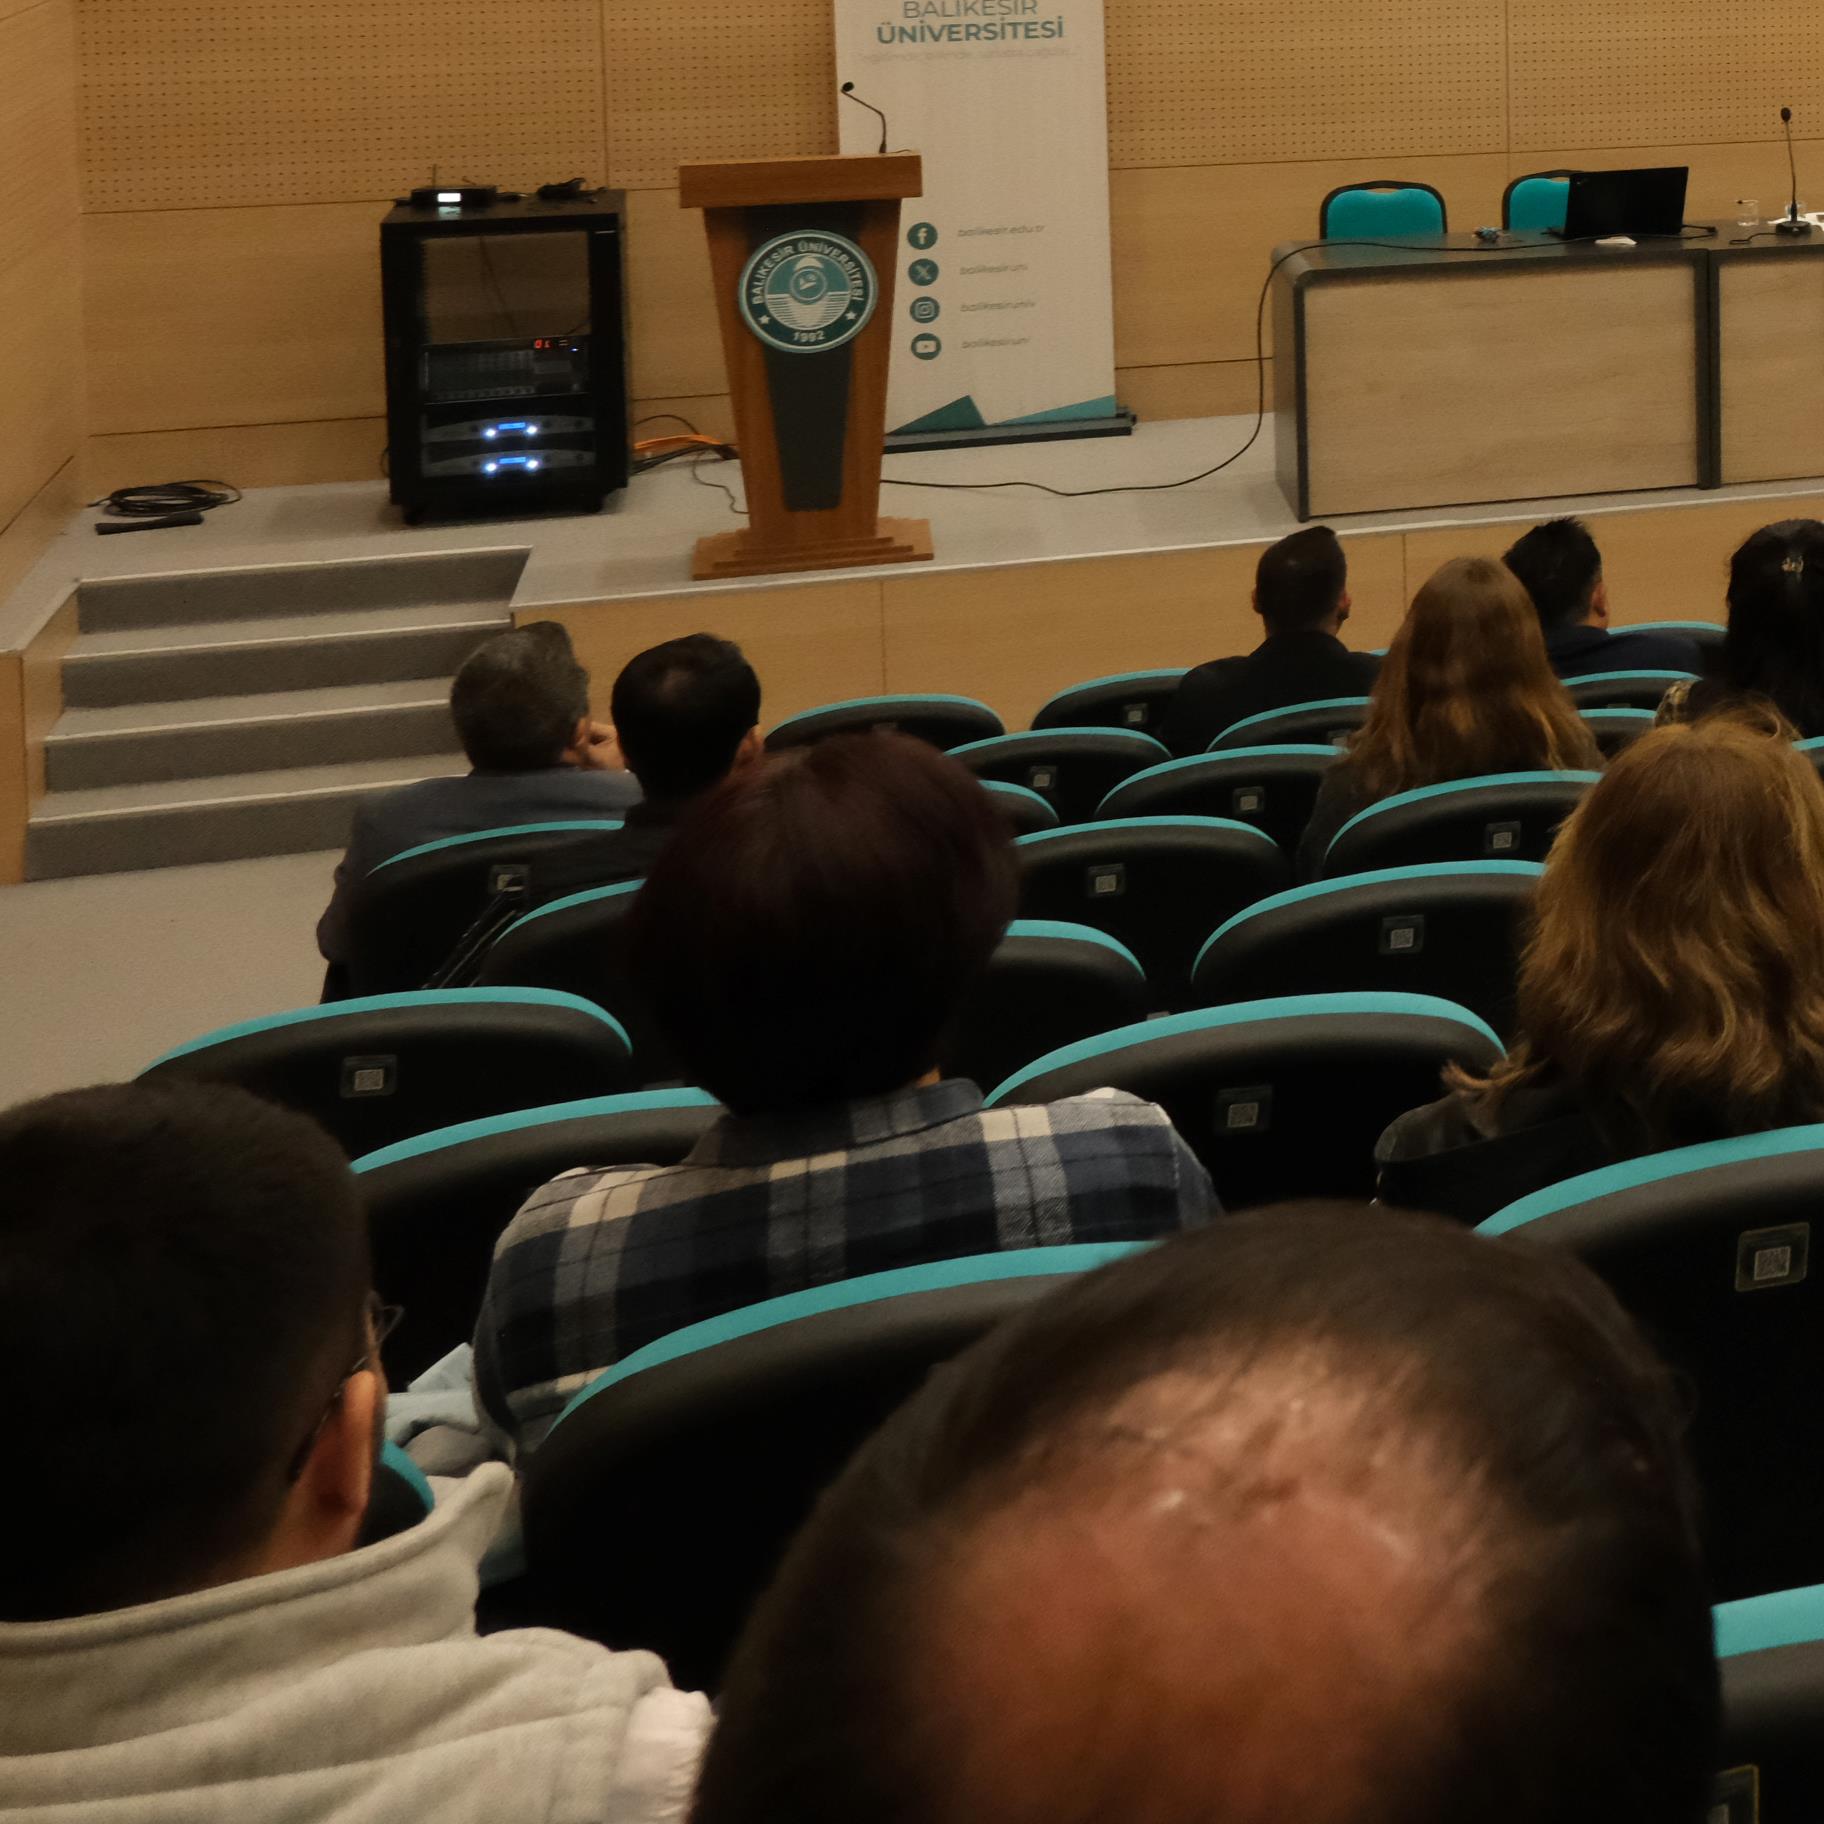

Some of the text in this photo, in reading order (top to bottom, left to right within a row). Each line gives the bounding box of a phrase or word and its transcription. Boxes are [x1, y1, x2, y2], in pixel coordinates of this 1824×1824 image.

[876, 15, 1064, 44] ÜNİVERSİTESİ
[752, 240, 864, 305] BALIKESİR ÜNİVERSİTESİ
[793, 330, 825, 342] 1992
